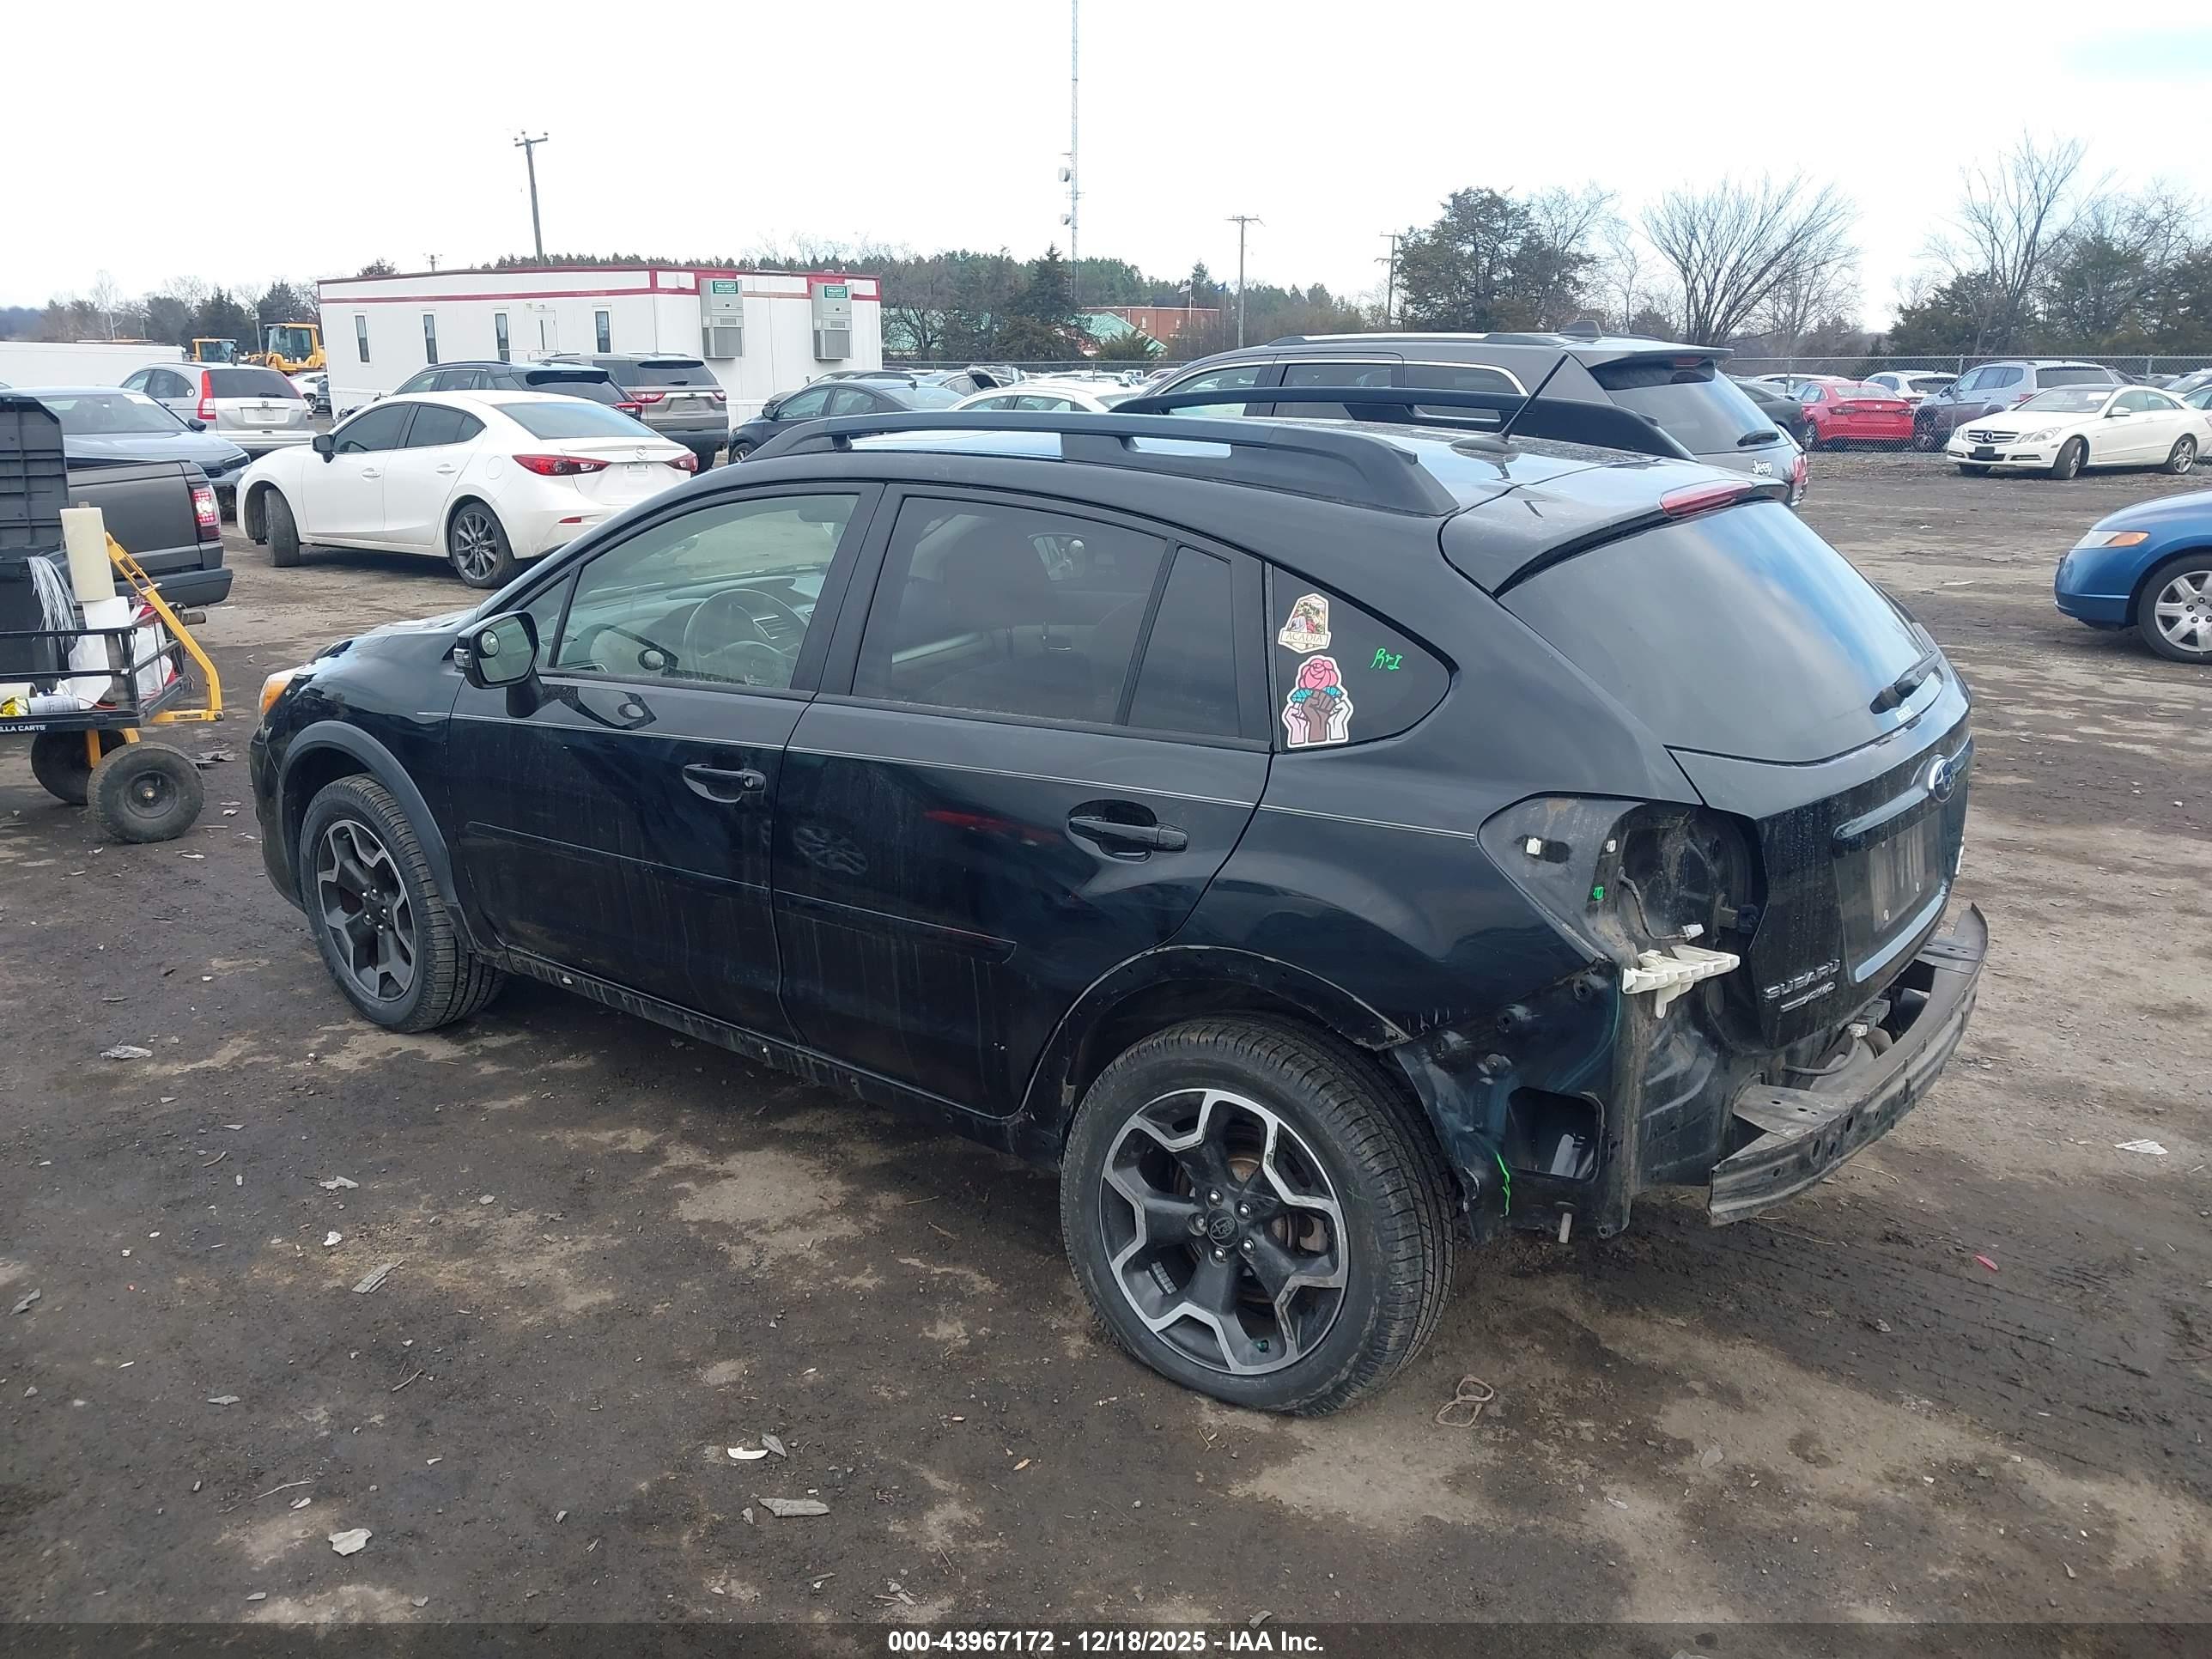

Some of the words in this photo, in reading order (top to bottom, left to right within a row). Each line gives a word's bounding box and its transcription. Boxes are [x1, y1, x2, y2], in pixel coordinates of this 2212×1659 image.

[1752, 459, 1772, 476] Jeep
[1285, 632, 1322, 643] ACADIA
[1763, 958, 1841, 1000] SUBARU
